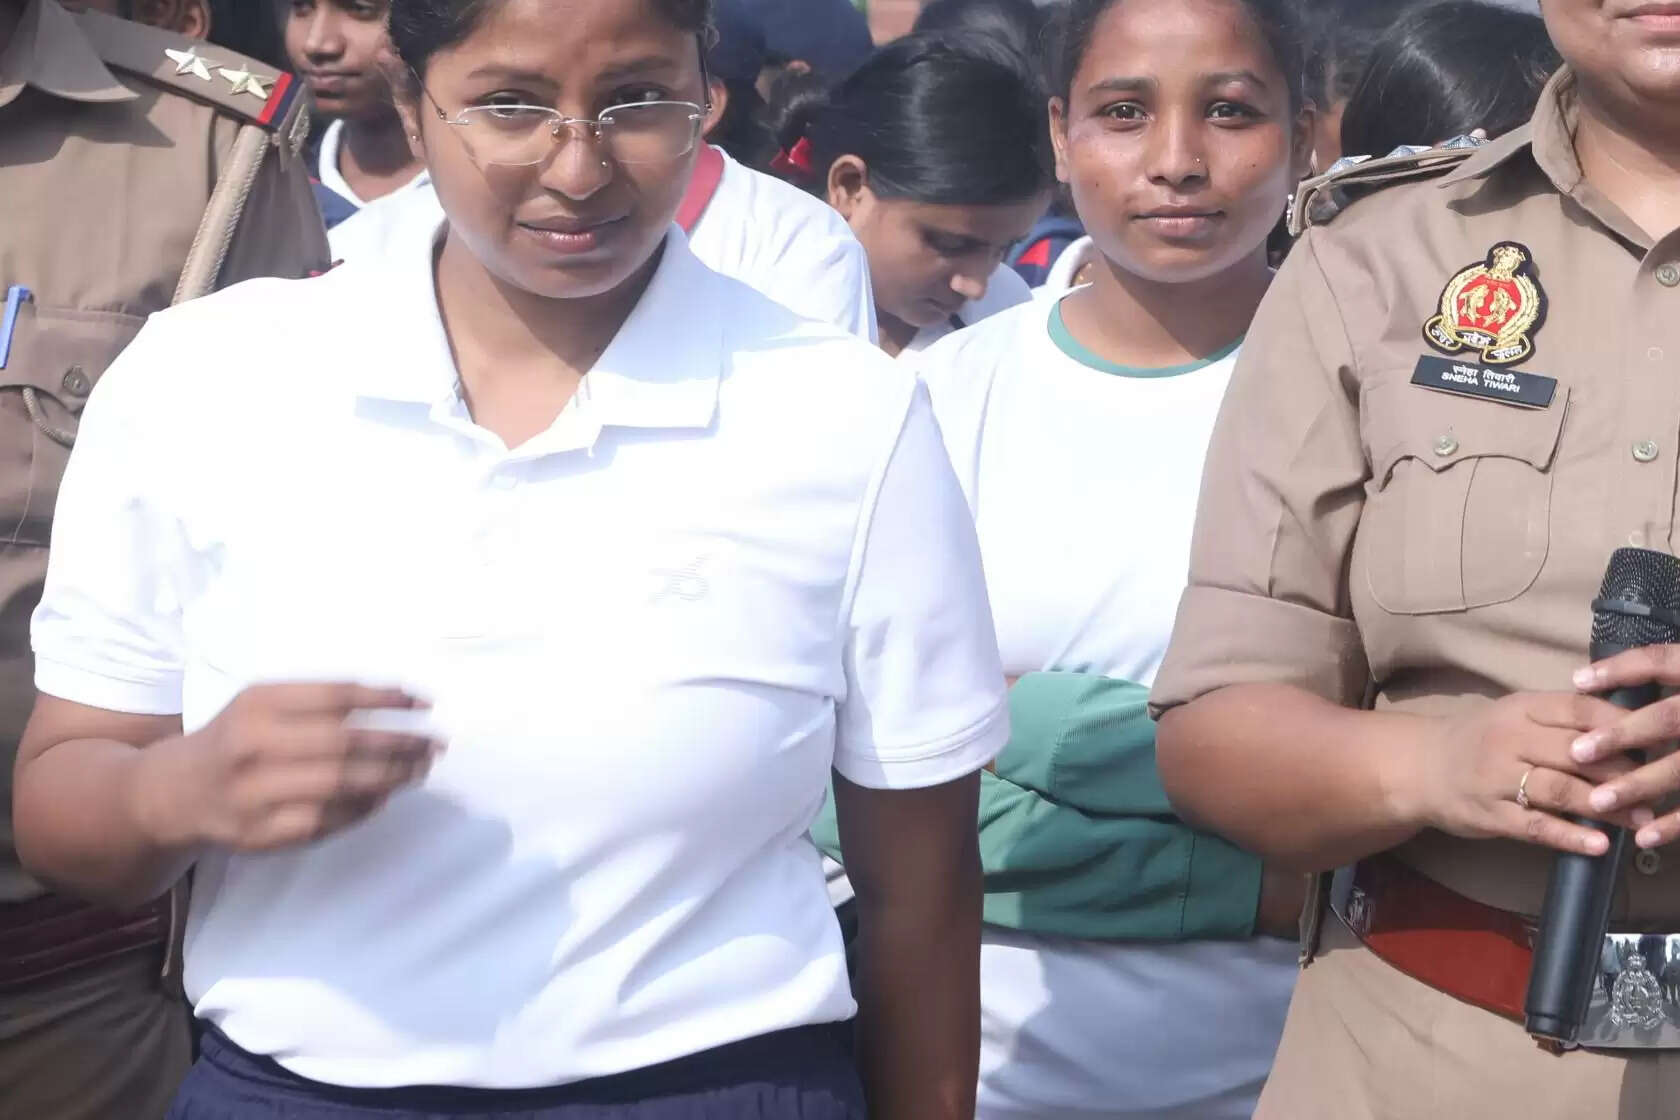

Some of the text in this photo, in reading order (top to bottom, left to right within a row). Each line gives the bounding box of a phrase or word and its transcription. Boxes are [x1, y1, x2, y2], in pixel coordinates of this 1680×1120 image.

[1441, 372, 1520, 392] SNEHA TIWARI
[1483, 369, 1515, 383] तिवारी
